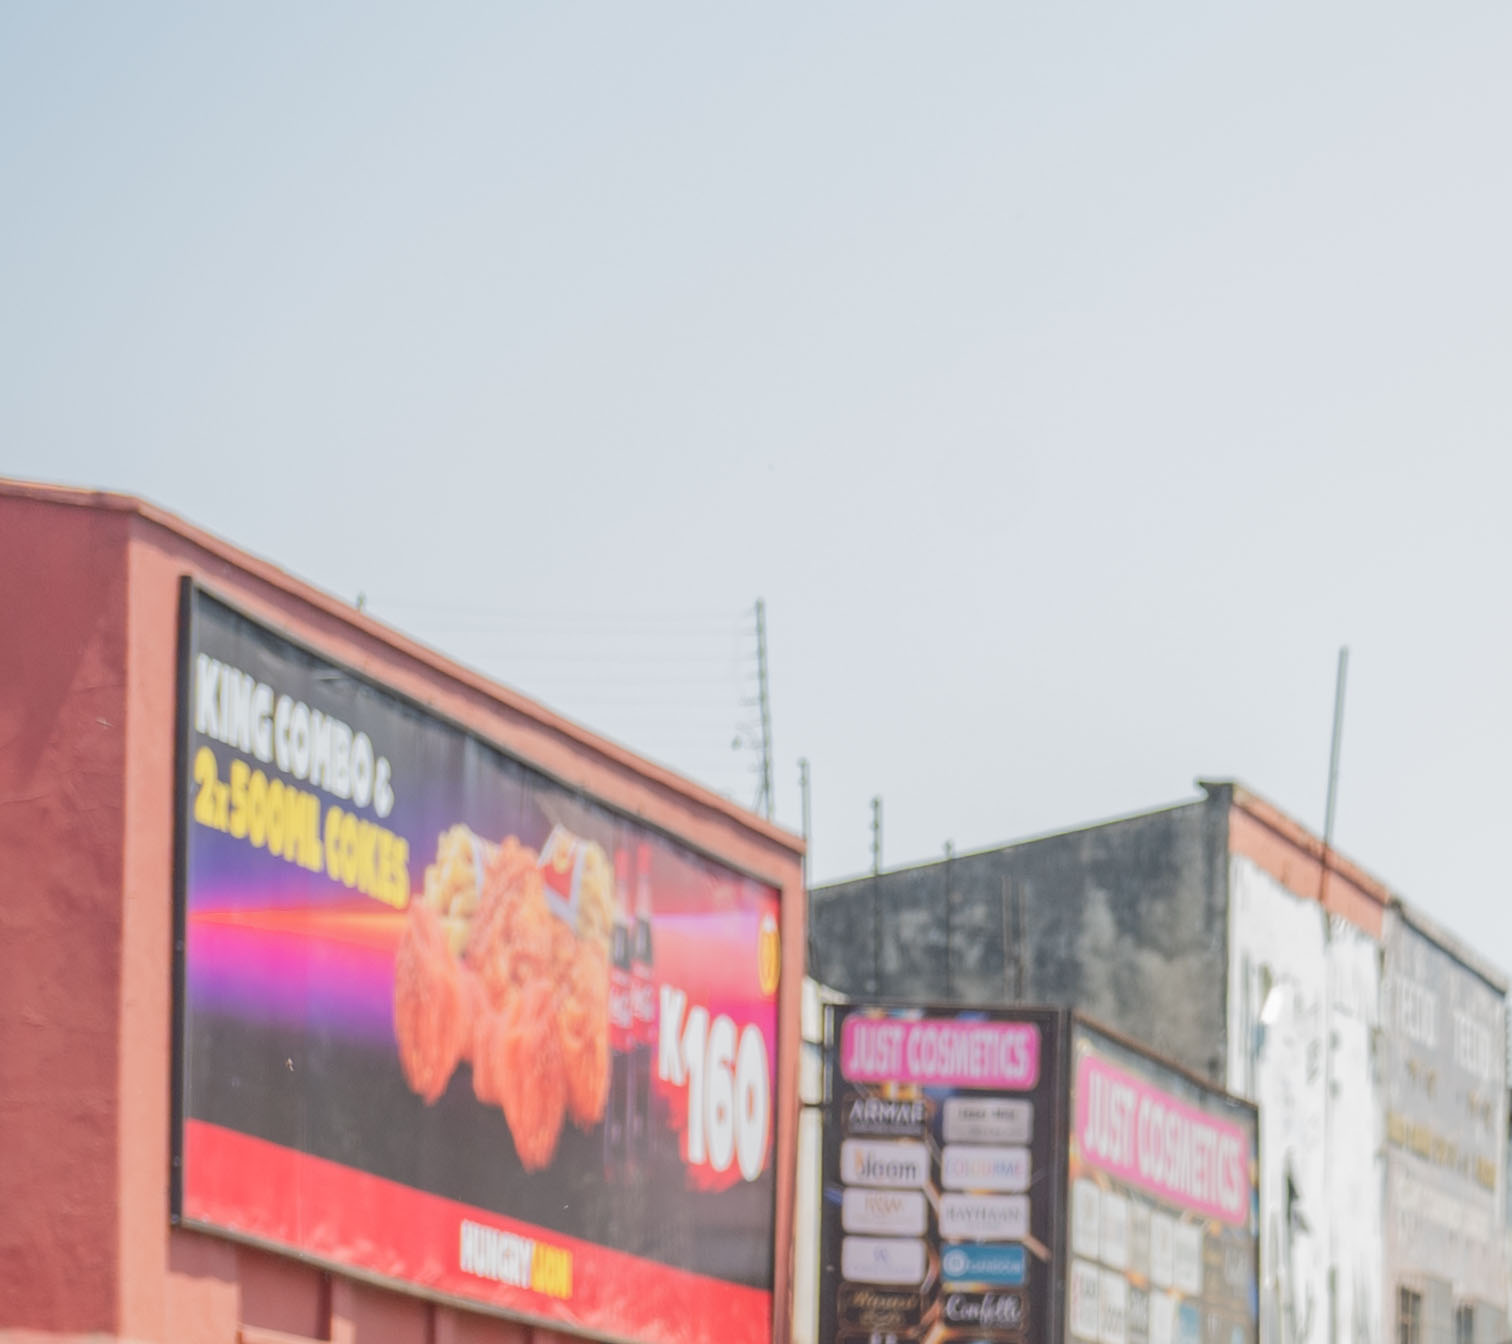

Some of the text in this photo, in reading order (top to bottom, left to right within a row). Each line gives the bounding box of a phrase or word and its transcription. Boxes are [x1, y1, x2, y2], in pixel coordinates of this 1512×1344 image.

[195, 652, 395, 818] KING COMBO &
[324, 805, 410, 910] COKES
[659, 982, 771, 1182] K160
[850, 1024, 1029, 1080] JUST COSMETICS
[1085, 1070, 1241, 1212] JUST COSMETICS
